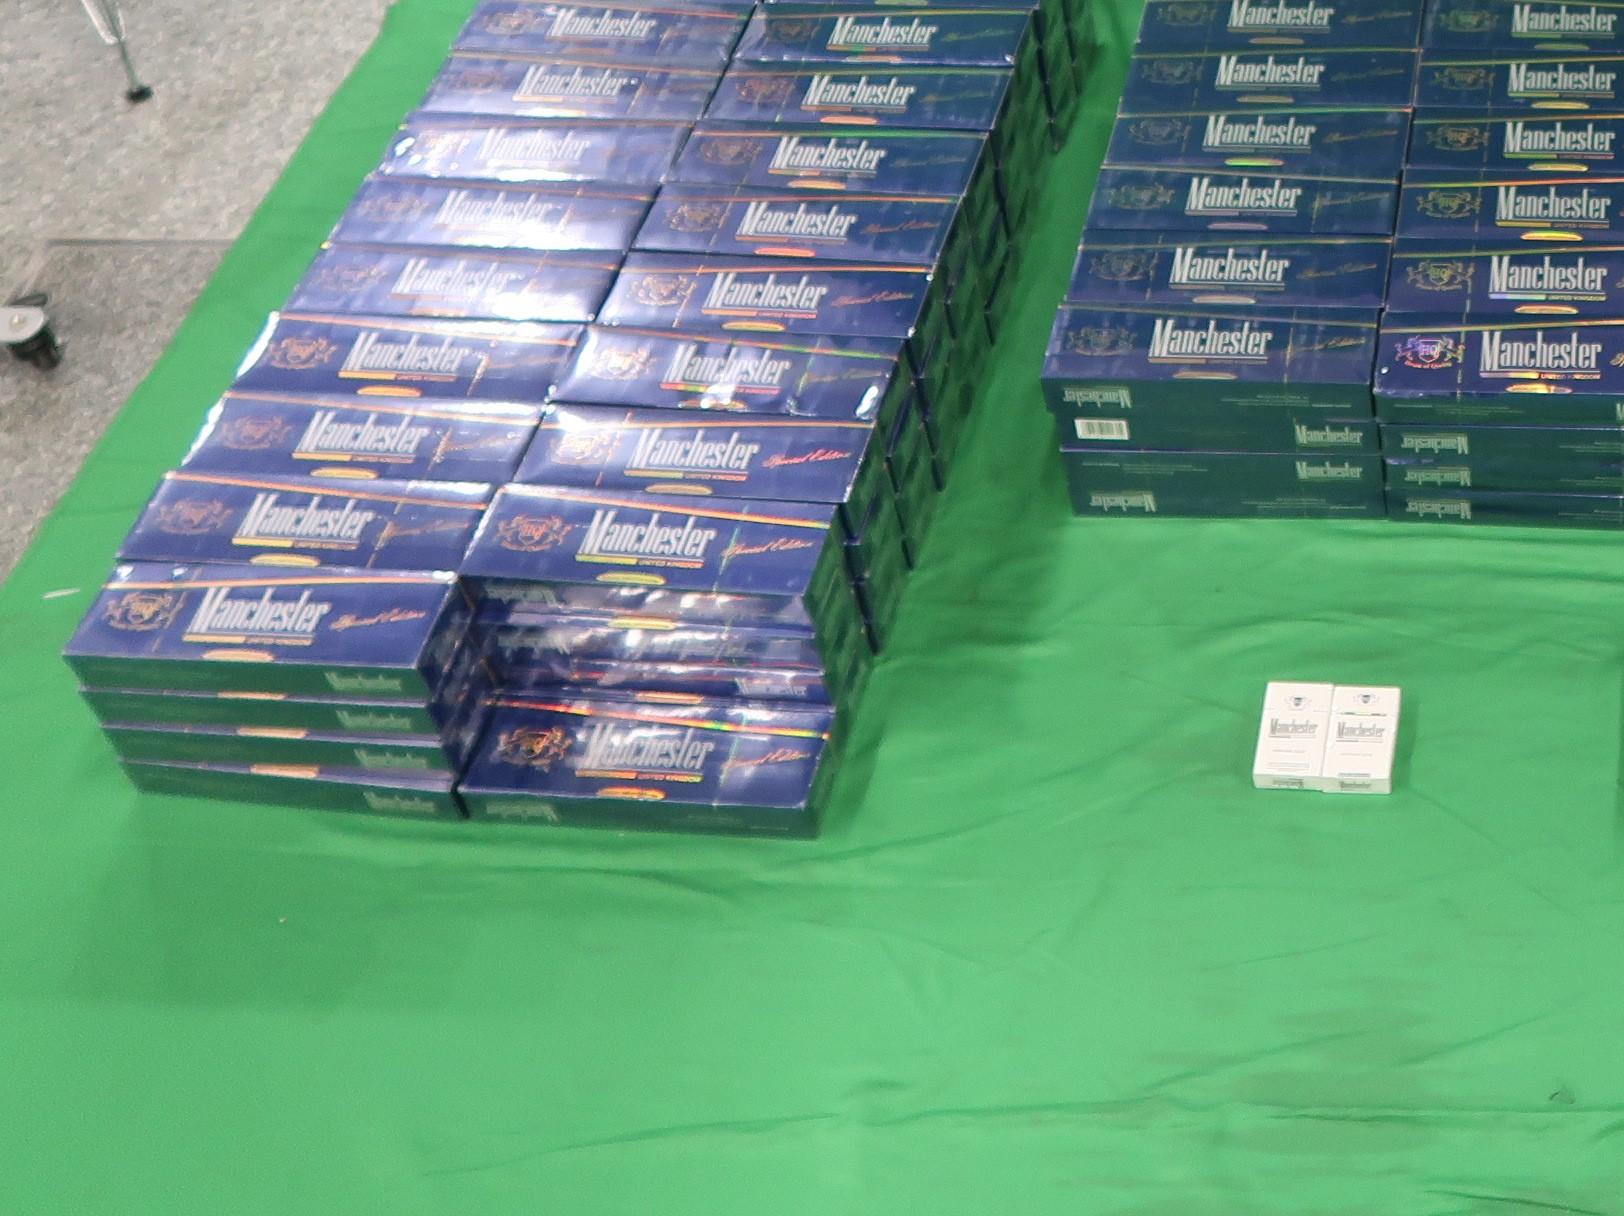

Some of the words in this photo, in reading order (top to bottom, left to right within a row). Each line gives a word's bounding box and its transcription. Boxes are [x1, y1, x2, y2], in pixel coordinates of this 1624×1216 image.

[547, 8, 657, 37] Manchester
[827, 16, 938, 45] Manchester
[1228, 0, 1334, 27] Manchester
[1512, 4, 1617, 32] Manchester
[513, 65, 626, 96] Manchester
[1216, 55, 1325, 85] Manchester
[1509, 63, 1616, 91] Manchester
[801, 73, 916, 105] Manchester
[1203, 115, 1316, 146] Manchester
[1504, 121, 1615, 152] Manchester
[769, 136, 887, 169] Manchester
[1186, 177, 1302, 209] Manchester
[1498, 186, 1611, 220] Manchester
[736, 201, 858, 236] Manchester
[1170, 248, 1291, 283] Manchester
[1489, 255, 1608, 292] Manchester
[703, 272, 828, 310] Manchester
[339, 332, 471, 372] Manchester
[1150, 319, 1273, 357] Manchester
[1480, 331, 1602, 371] Manchester
[662, 343, 792, 386] Manchester
[294, 409, 430, 454] Manchester
[626, 429, 760, 471] Manchester
[233, 493, 377, 538] Manchester
[577, 509, 716, 558] Manchester
[186, 587, 332, 633] Manchester
